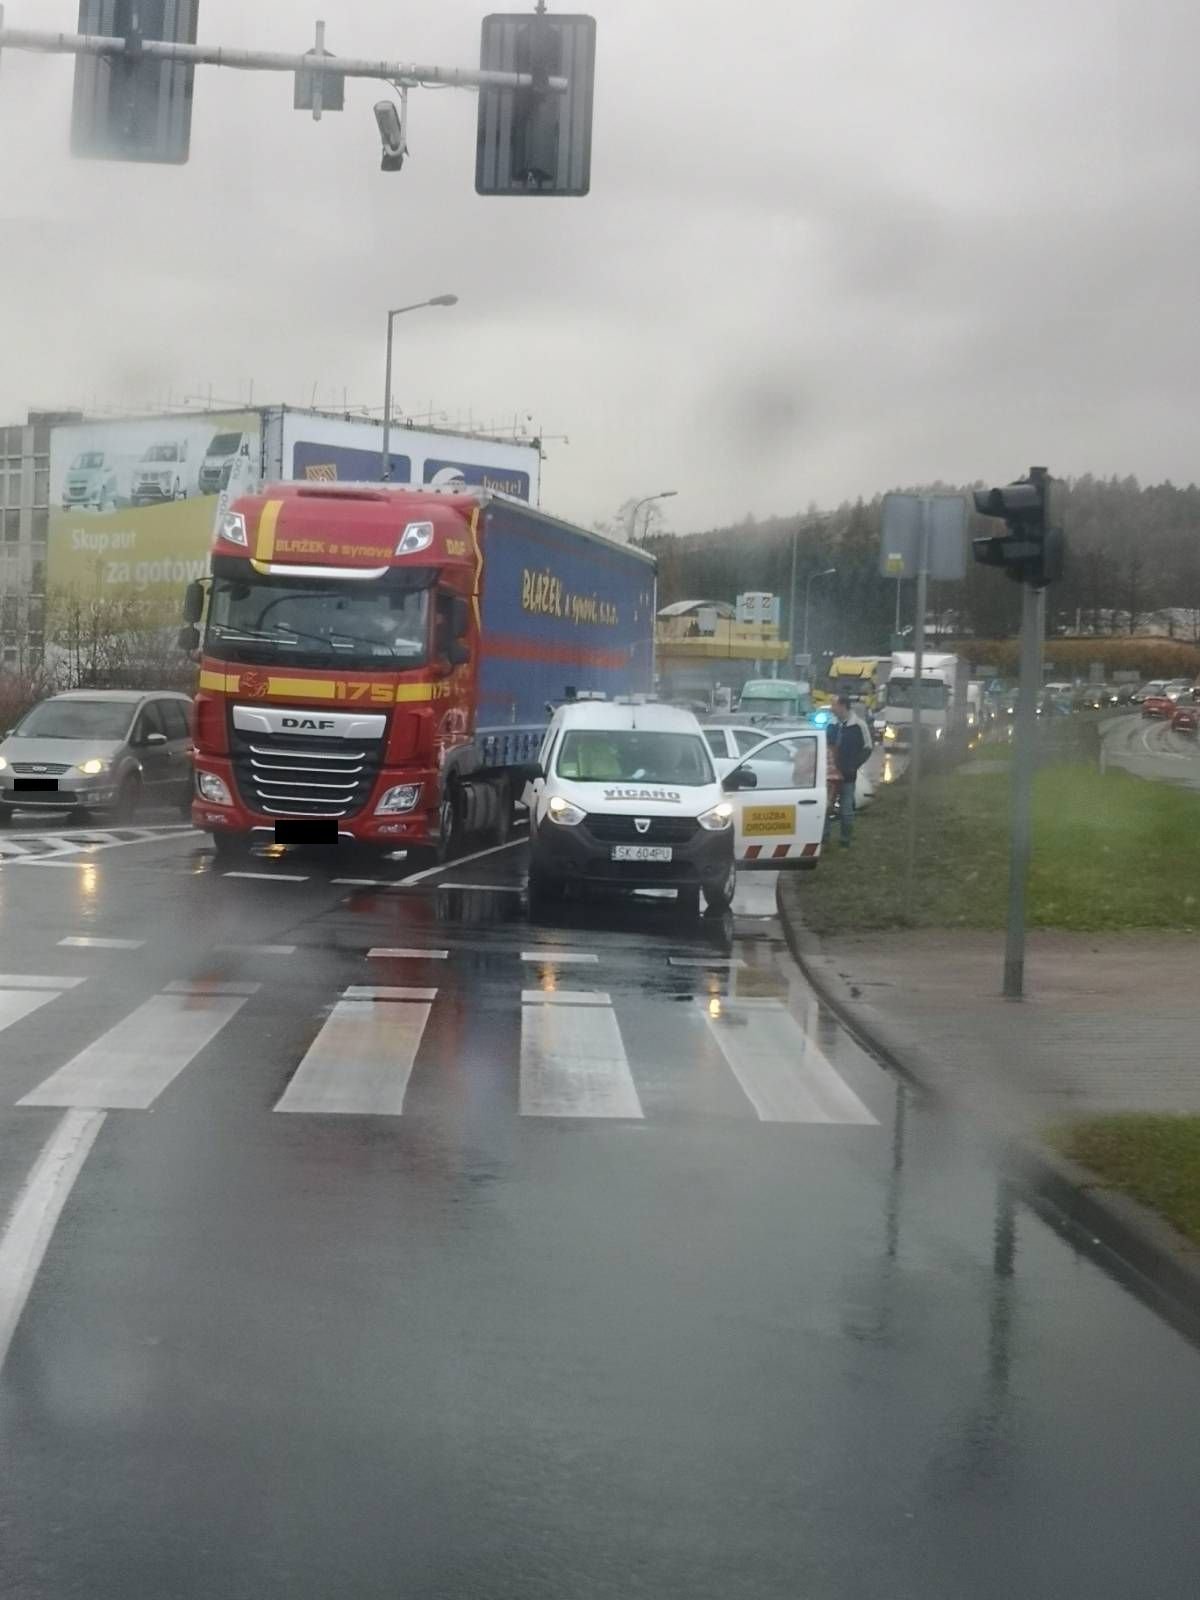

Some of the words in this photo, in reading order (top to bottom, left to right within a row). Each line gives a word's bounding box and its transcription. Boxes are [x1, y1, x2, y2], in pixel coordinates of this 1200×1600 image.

[71, 528, 109, 554] Skup
[329, 543, 338, 554] a
[105, 561, 130, 583] za
[135, 556, 211, 592] gotów
[522, 567, 561, 616] BLAŽEK
[336, 681, 394, 701] 175
[281, 718, 336, 730] DAF
[618, 847, 632, 858] SK
